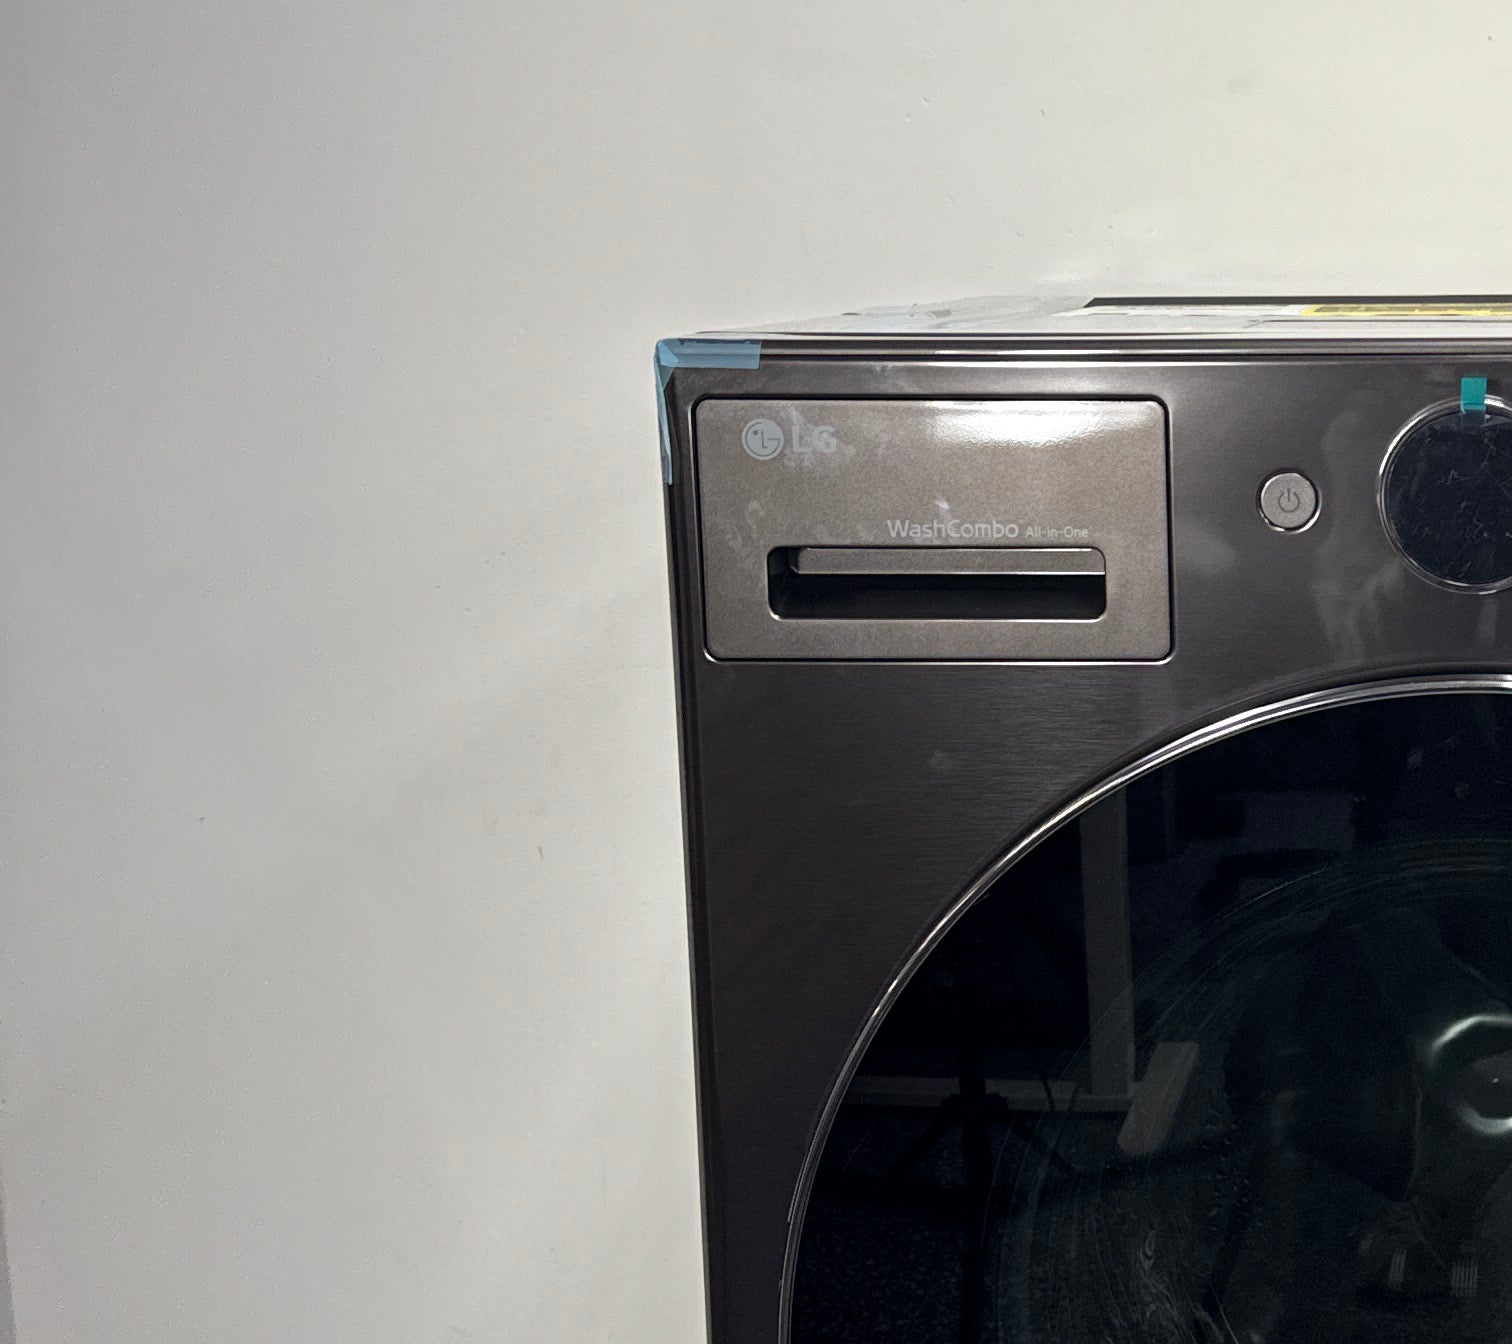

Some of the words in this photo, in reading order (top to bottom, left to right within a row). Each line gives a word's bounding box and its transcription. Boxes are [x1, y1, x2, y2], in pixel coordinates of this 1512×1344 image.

[791, 425, 837, 454] LG
[887, 519, 1019, 538] WashCombo
[1025, 525, 1089, 538] All-in-One
